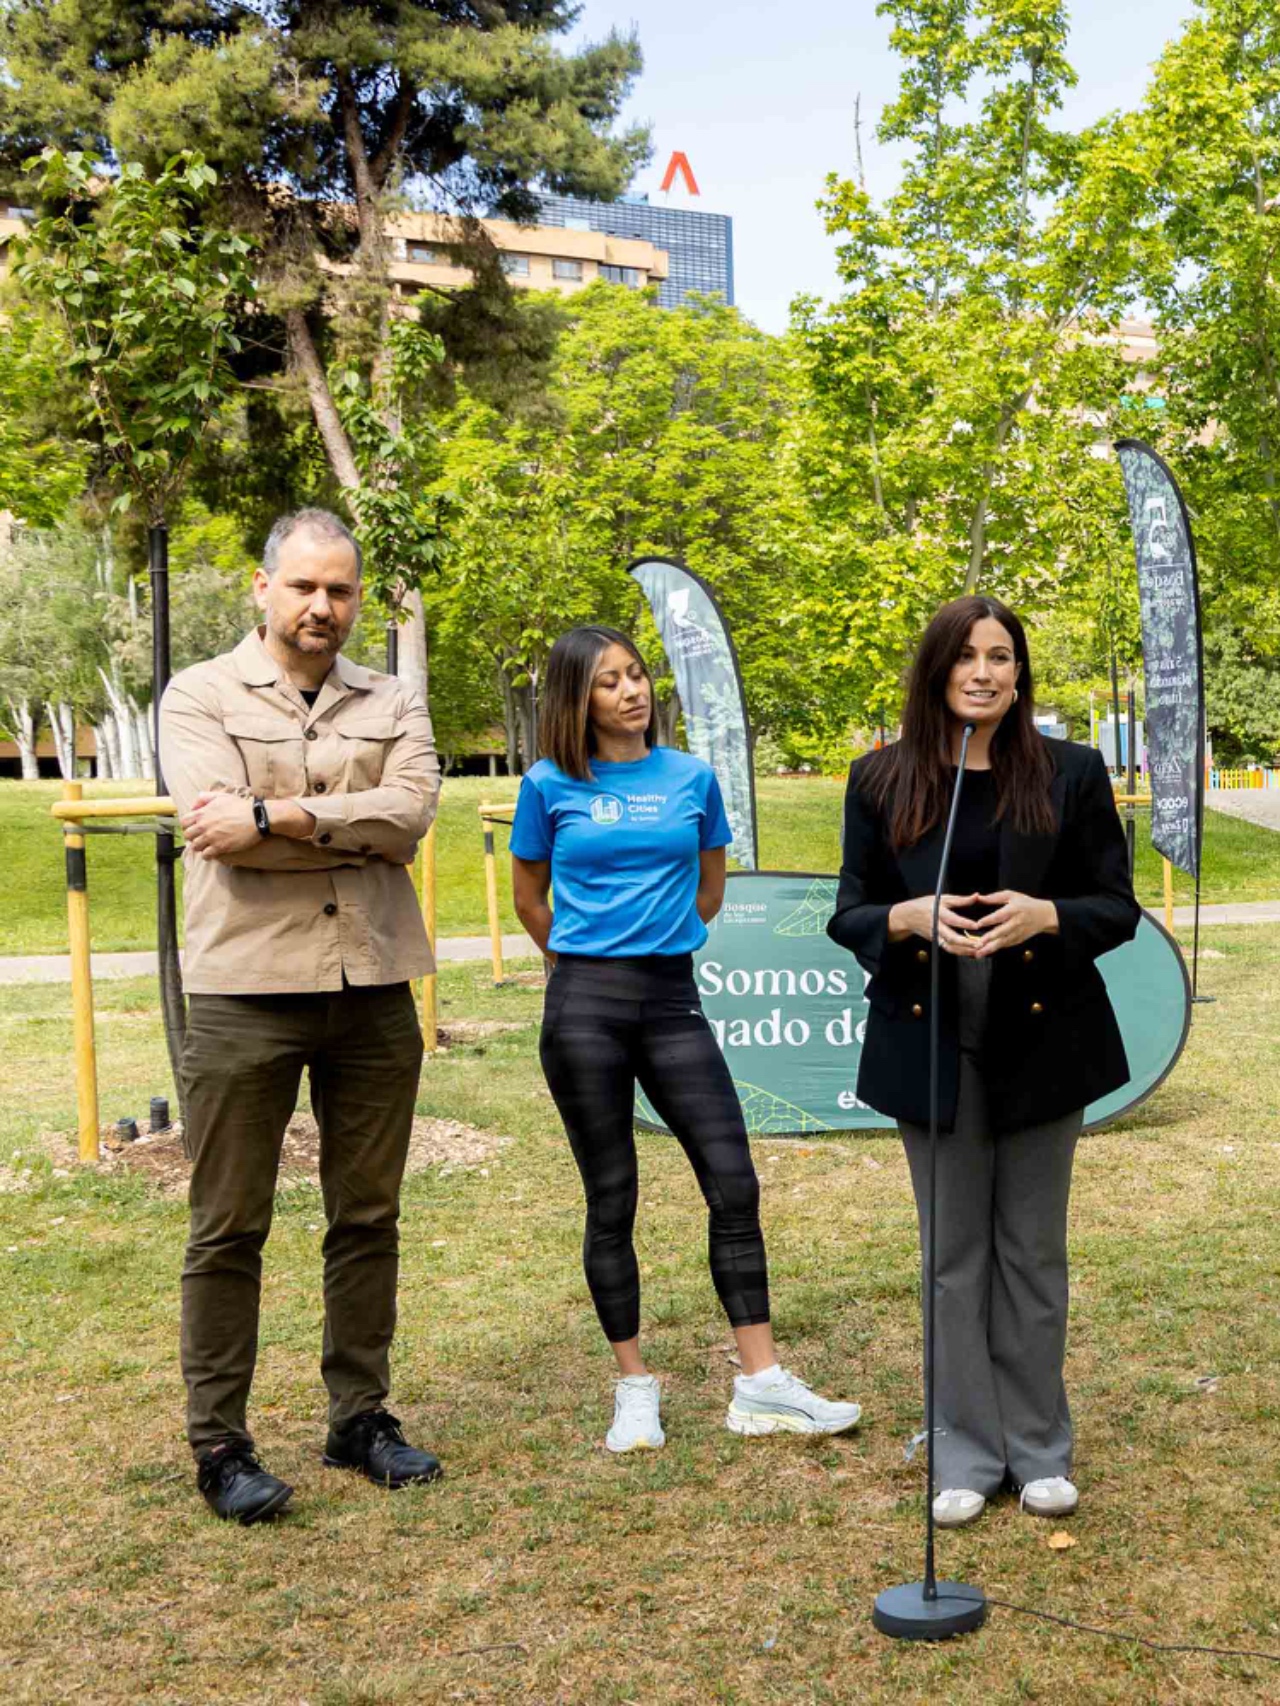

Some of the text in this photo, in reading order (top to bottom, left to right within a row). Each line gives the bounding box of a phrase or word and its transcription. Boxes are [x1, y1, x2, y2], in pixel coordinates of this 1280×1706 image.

[626, 794, 667, 804] Healthy
[627, 804, 658, 813] Cities
[699, 961, 848, 996] Somos
